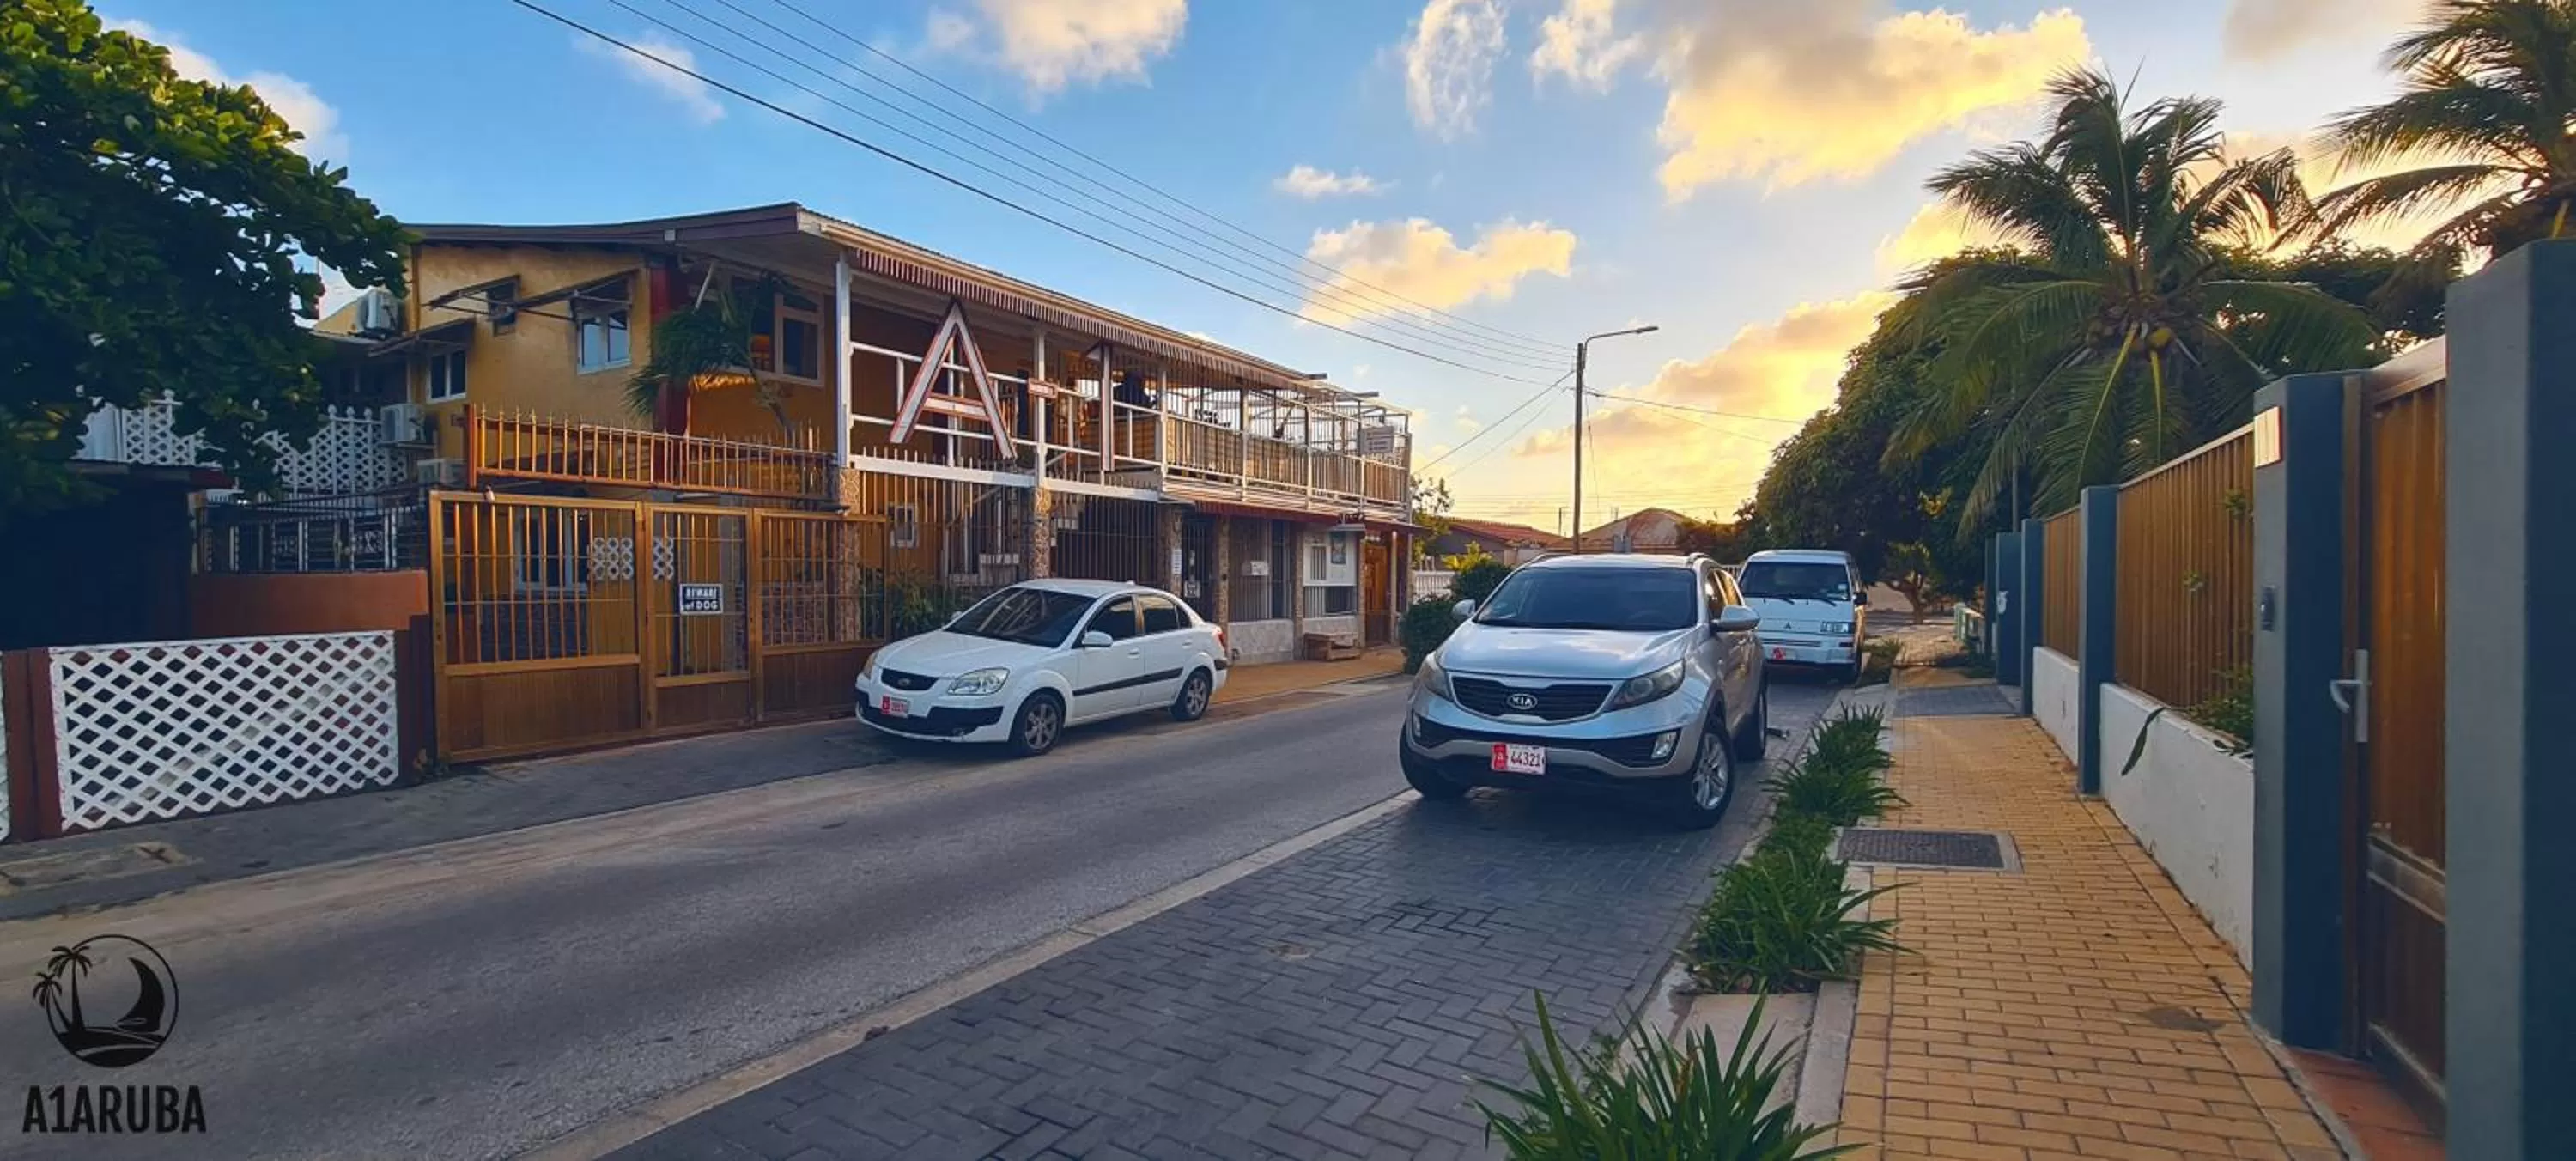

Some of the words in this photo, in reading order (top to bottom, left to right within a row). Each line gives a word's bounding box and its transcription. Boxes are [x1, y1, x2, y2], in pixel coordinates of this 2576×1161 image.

[696, 600, 718, 610] DOG
[1512, 696, 1533, 707] KIA
[1511, 751, 1540, 767] 44321
